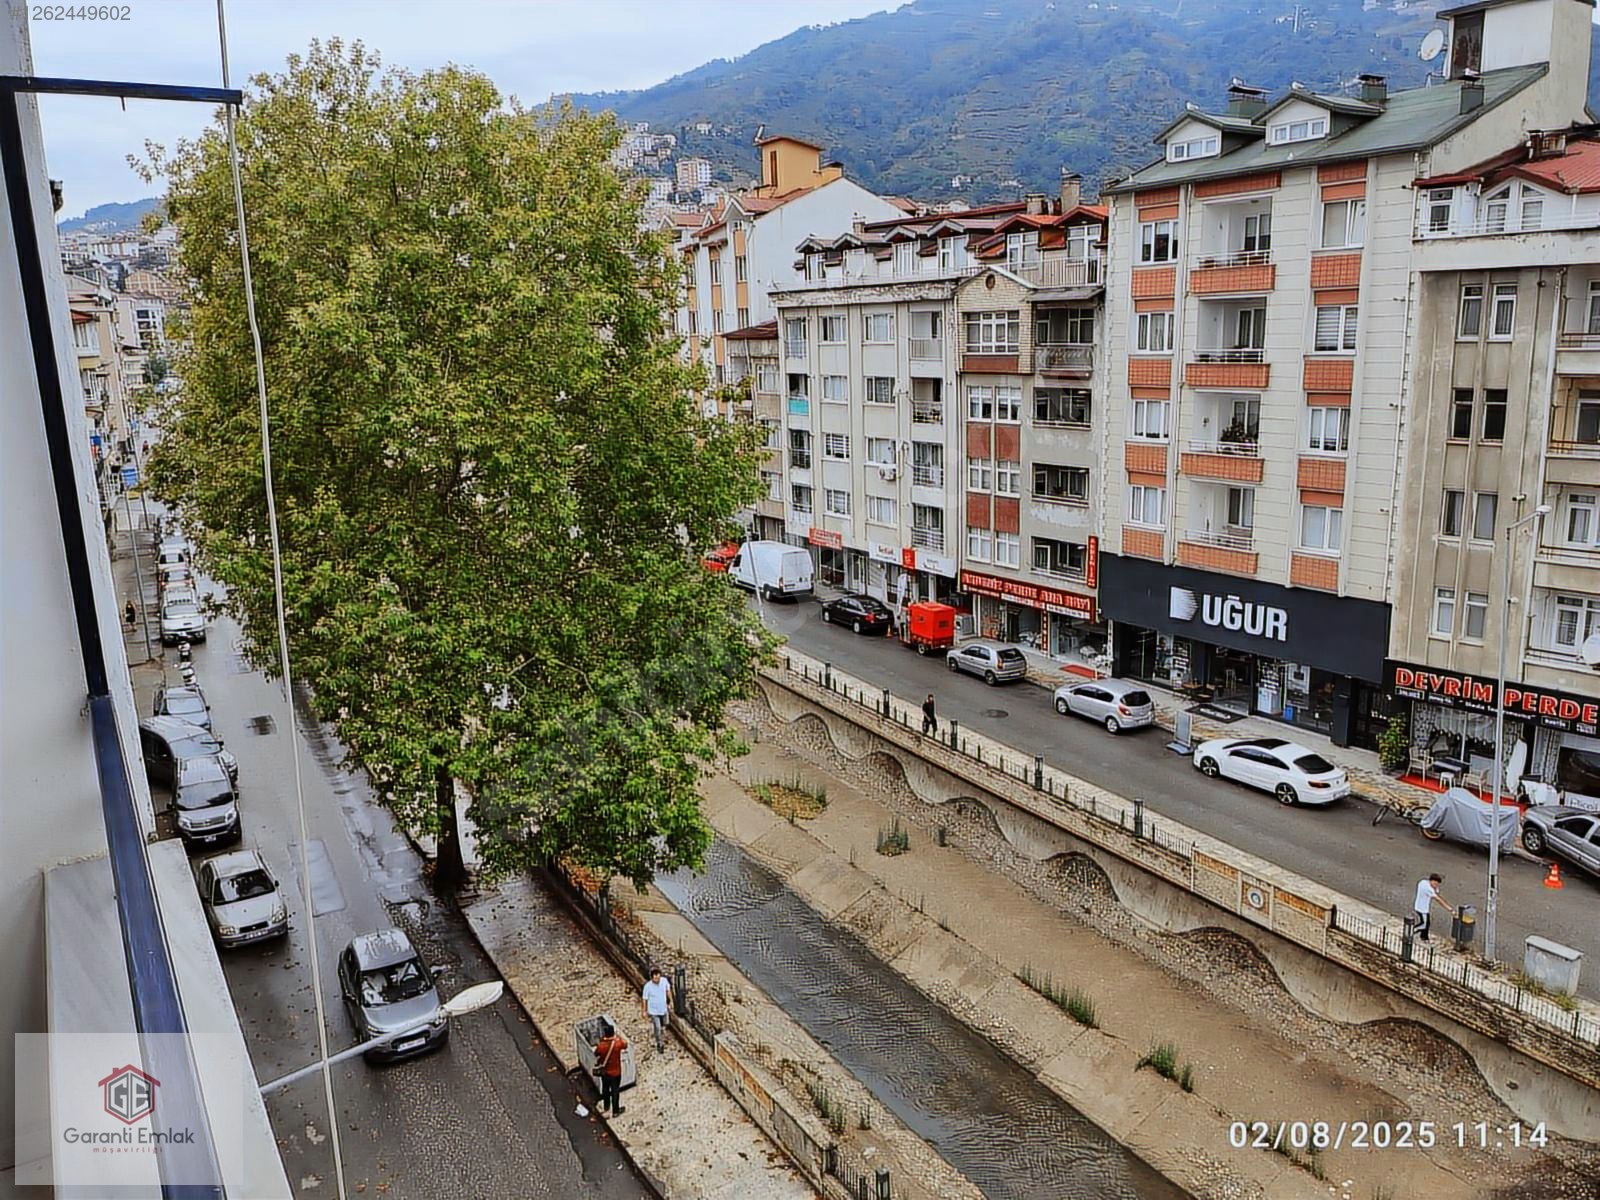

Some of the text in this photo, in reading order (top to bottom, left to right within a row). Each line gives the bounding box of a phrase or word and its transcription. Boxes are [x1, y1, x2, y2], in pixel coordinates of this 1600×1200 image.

[1202, 594, 1288, 641] UĞUR
[1396, 667, 1598, 724] DEVRİM PERDE
